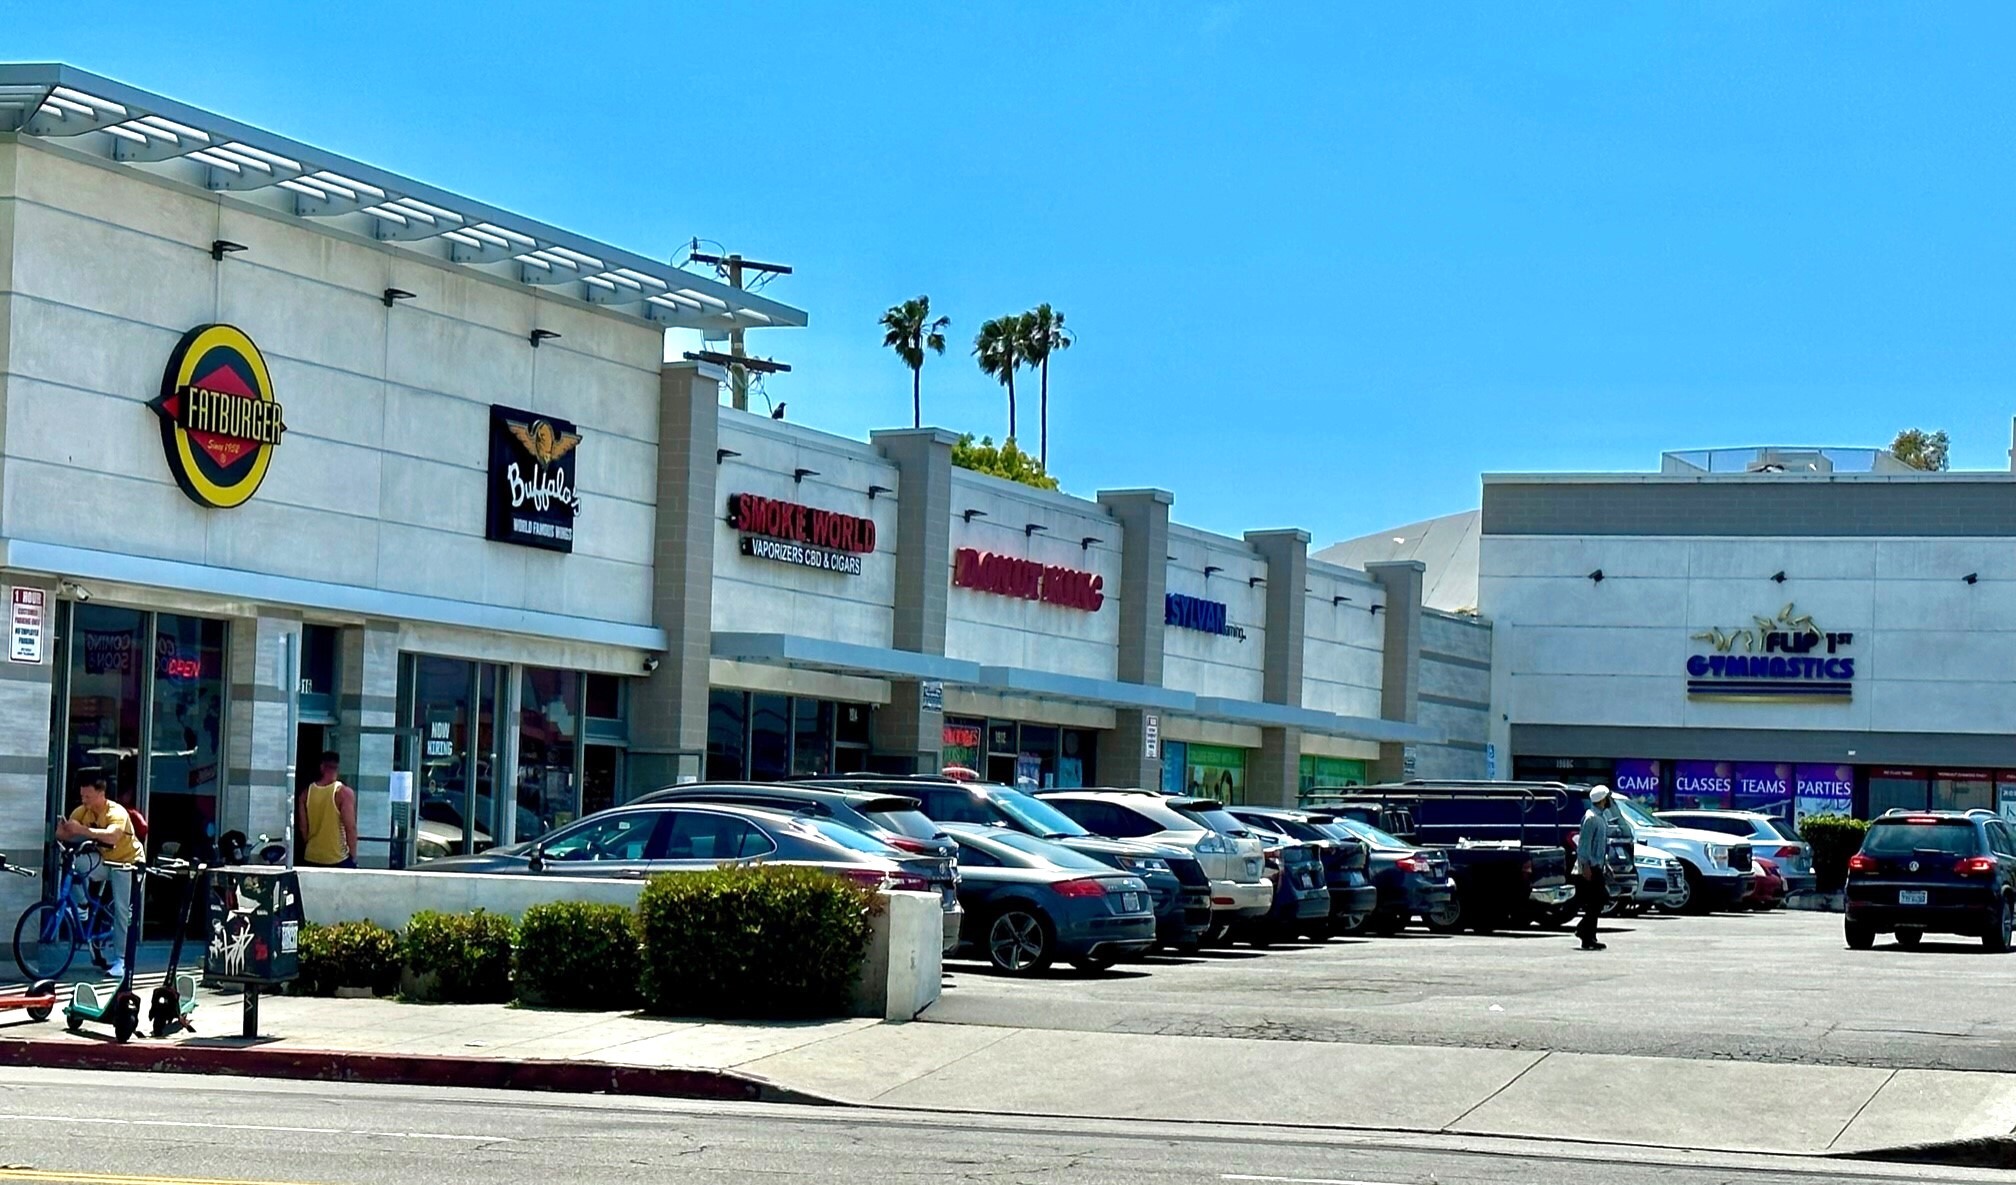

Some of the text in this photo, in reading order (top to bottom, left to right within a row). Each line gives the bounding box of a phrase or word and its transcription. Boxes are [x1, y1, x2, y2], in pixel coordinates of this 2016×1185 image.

[188, 386, 282, 444] FATBURGER
[507, 461, 582, 516] Buffalo's
[513, 517, 533, 534] WORLD
[737, 492, 876, 554] SMOKE WORLD
[751, 538, 861, 575] VAPORIZERS CBD & CIGARS
[1167, 592, 1227, 636] SYLVAN
[1765, 631, 1820, 654] FLIP
[168, 658, 200, 678] OPEN
[1686, 654, 1855, 680] GYMNASTICS
[430, 721, 451, 739] NOW
[426, 740, 453, 756] HIRING
[1617, 775, 1660, 791] CAMP
[1676, 776, 1732, 792] CLASSES
[1740, 779, 1786, 794] TEAMS
[1797, 781, 1852, 796] PARTIES
